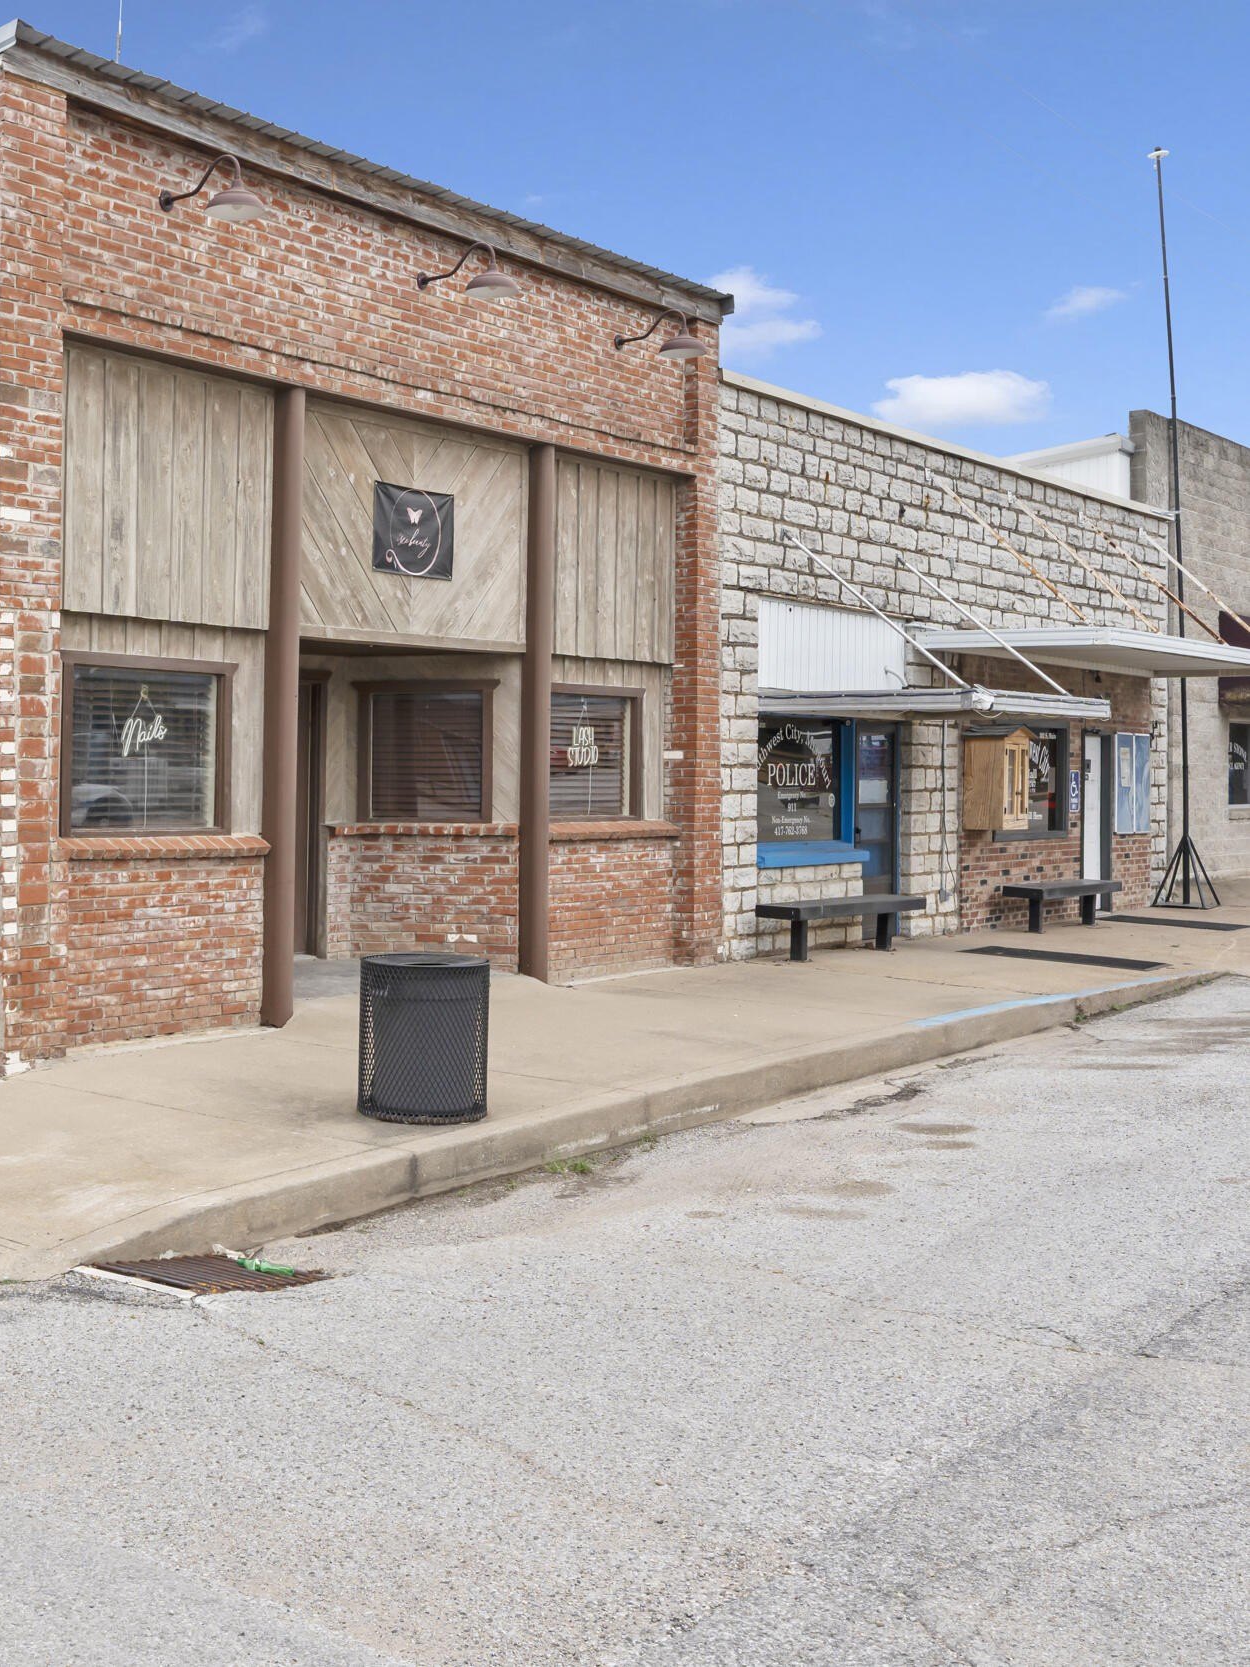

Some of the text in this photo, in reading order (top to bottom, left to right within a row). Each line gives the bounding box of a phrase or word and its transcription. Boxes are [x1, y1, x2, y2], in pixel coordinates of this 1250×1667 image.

[121, 714, 168, 757] Nails
[573, 726, 595, 746] LASH
[568, 745, 599, 767] STUDIO
[757, 727, 784, 771] uthwest
[767, 763, 816, 787] POLICE
[787, 802, 797, 812] 911
